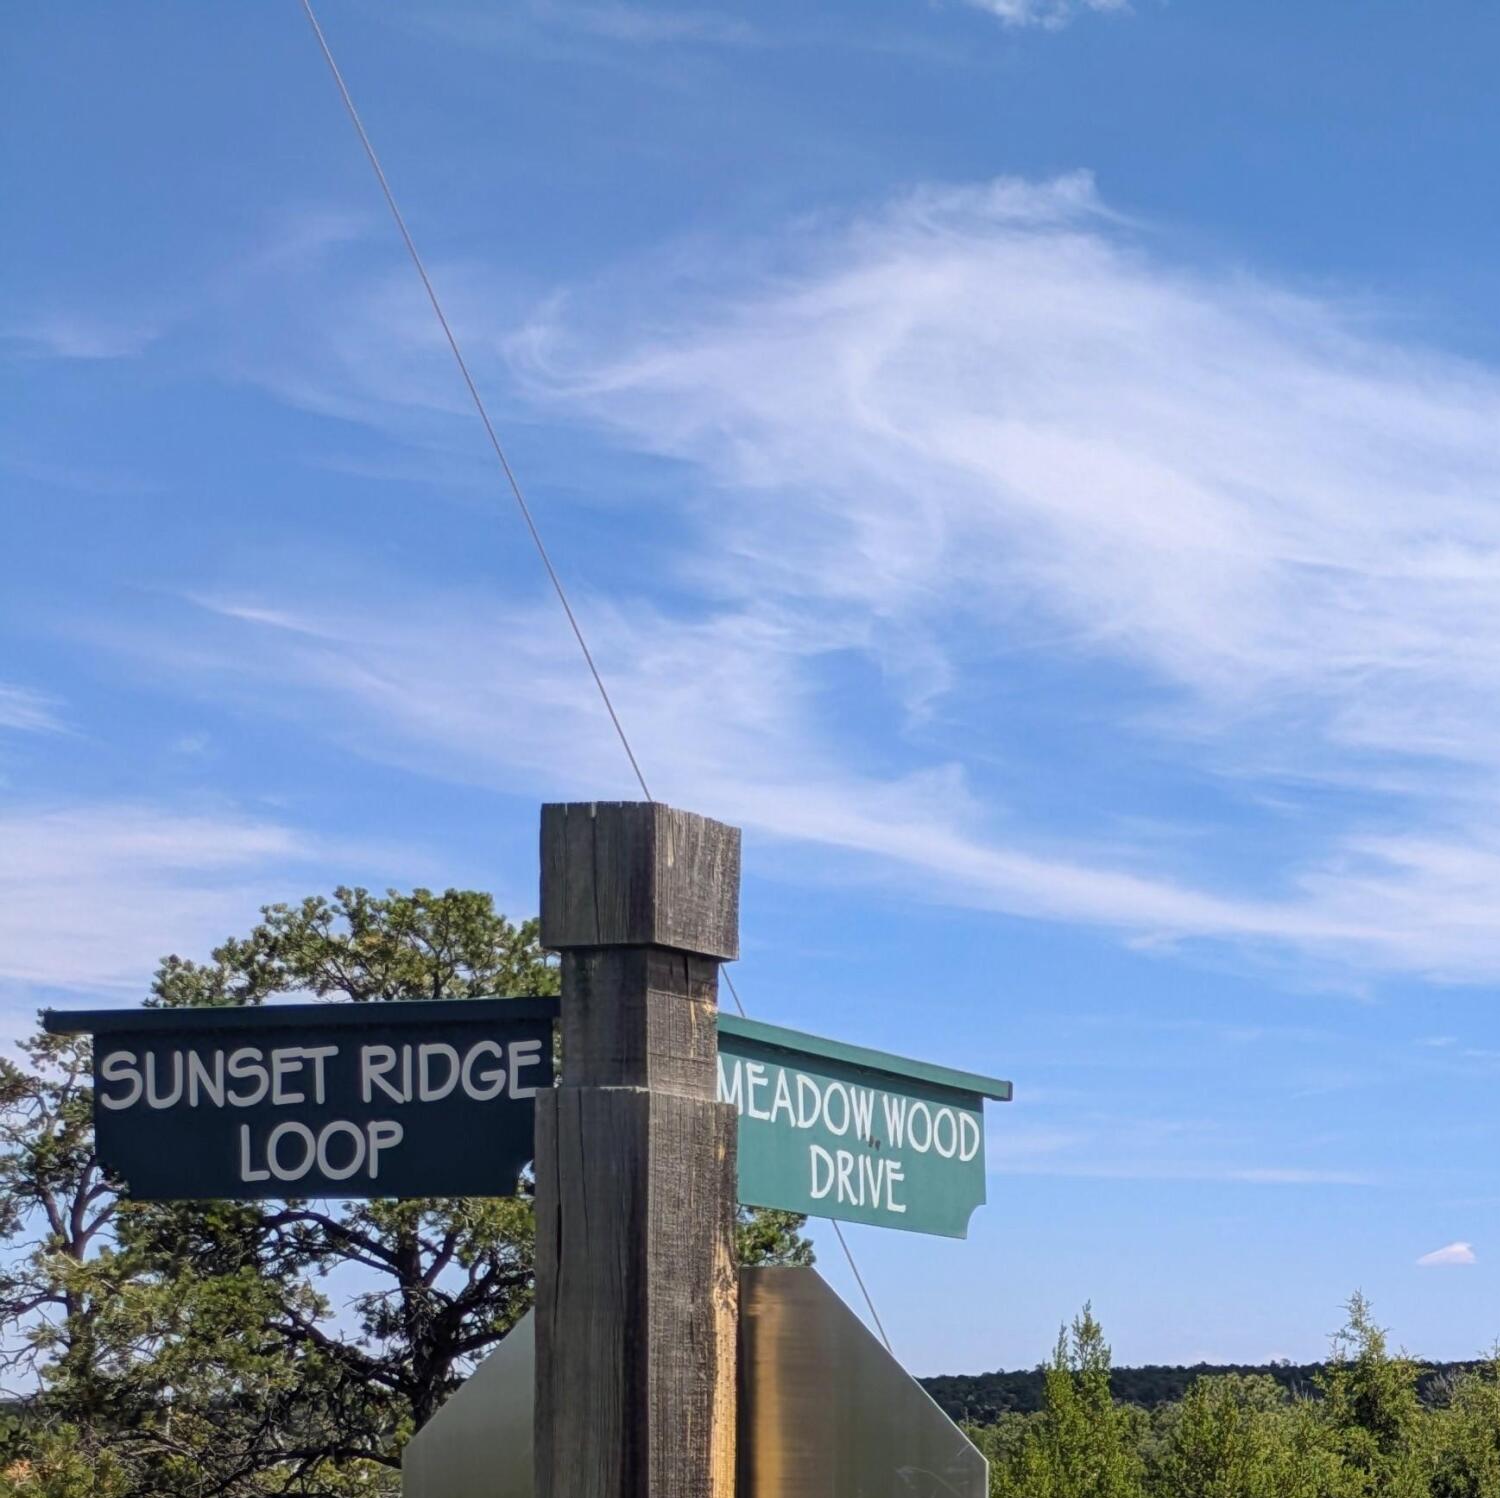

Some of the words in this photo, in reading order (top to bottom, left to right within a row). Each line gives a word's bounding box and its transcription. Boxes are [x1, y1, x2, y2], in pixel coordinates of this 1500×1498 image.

[101, 1045, 339, 1110] SUNSET
[361, 1039, 542, 1103] RIDGE
[716, 1054, 874, 1142] MEADOW
[883, 1093, 980, 1162] WOOD
[240, 1120, 403, 1183] LOOP
[809, 1144, 906, 1213] DRIVE
